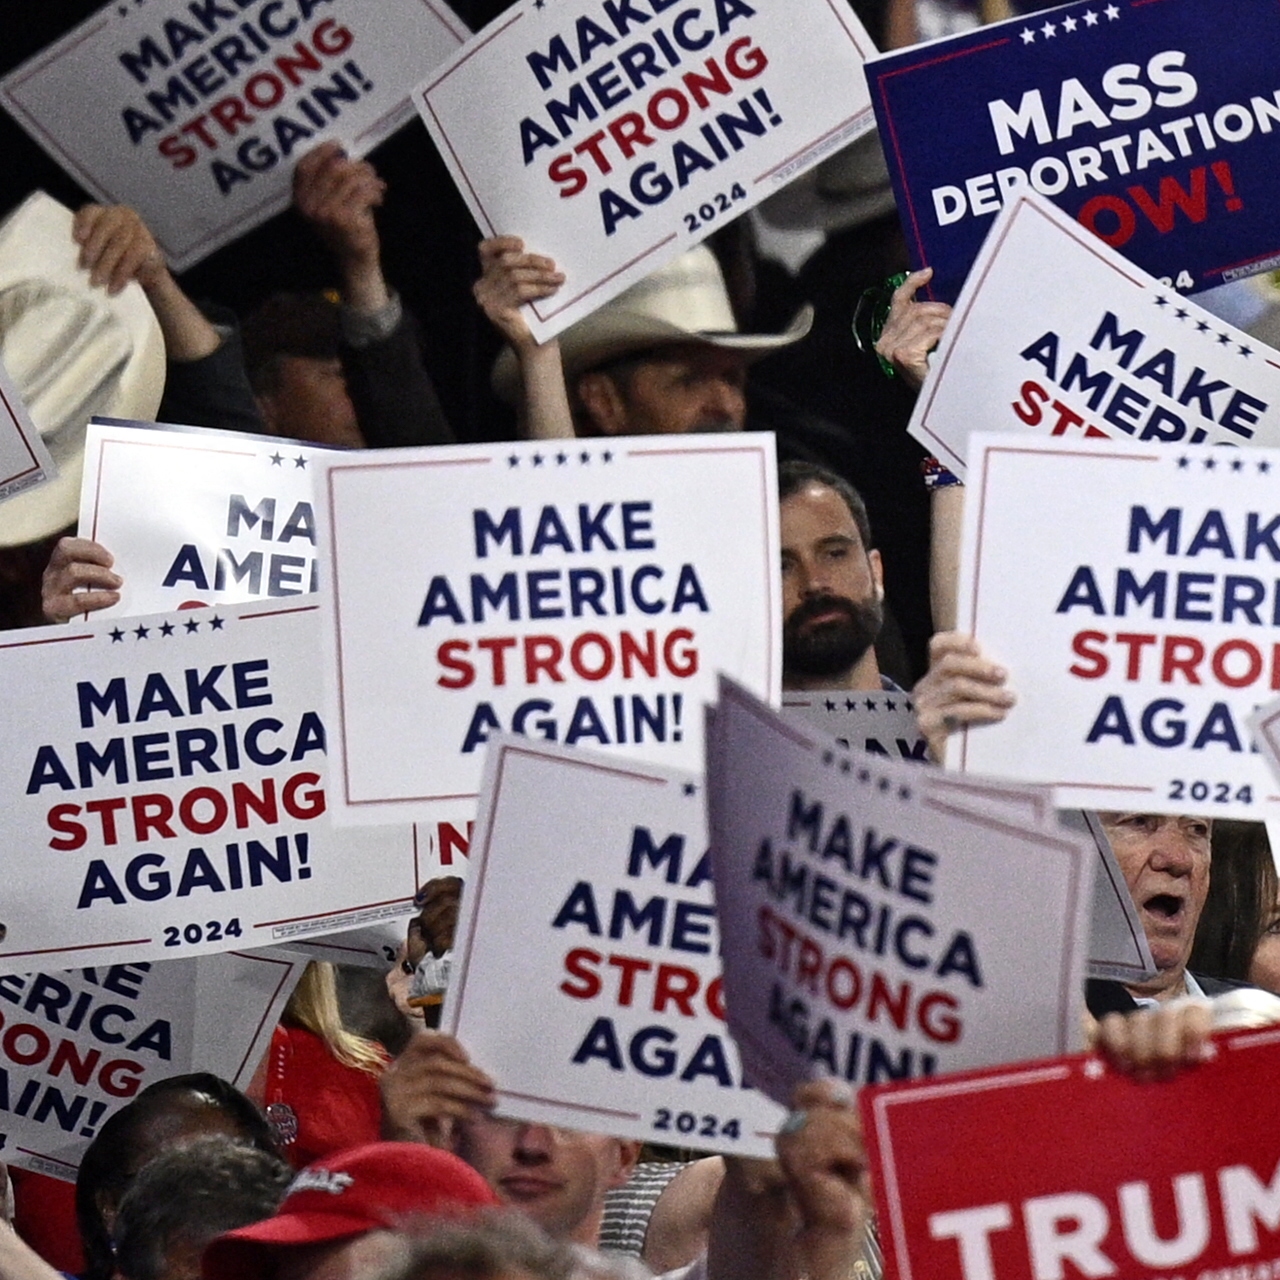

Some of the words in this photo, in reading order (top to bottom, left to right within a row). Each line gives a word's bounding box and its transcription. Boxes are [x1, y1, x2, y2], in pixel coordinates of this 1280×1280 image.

[157, 18, 353, 170] STRONG
[209, 60, 374, 196] AGAIN!
[547, 36, 768, 200] STRONG
[987, 50, 1198, 156] MASS
[598, 88, 783, 236] AGAIN!
[682, 181, 747, 234] 2024
[1078, 160, 1243, 250] OW!
[1089, 311, 1269, 439] MAKE
[227, 493, 318, 543] MA
[472, 500, 655, 559] MAKE
[416, 564, 711, 626] AMERICA
[76, 659, 274, 728] MAKE
[436, 628, 699, 690] STRONG
[26, 711, 327, 795] AMERICA
[461, 694, 683, 755] AGAIN!
[1086, 695, 1262, 754] AGA
[47, 772, 327, 851] STRONG
[1168, 779, 1254, 805] 2024
[77, 833, 311, 910] AGAIN!
[787, 791, 939, 905] MAKE
[163, 918, 242, 948] 2024
[752, 835, 984, 989] AMERICA
[758, 904, 962, 1045] STRONG
[2, 1023, 146, 1098] ONG
[652, 1107, 742, 1140] 2024
